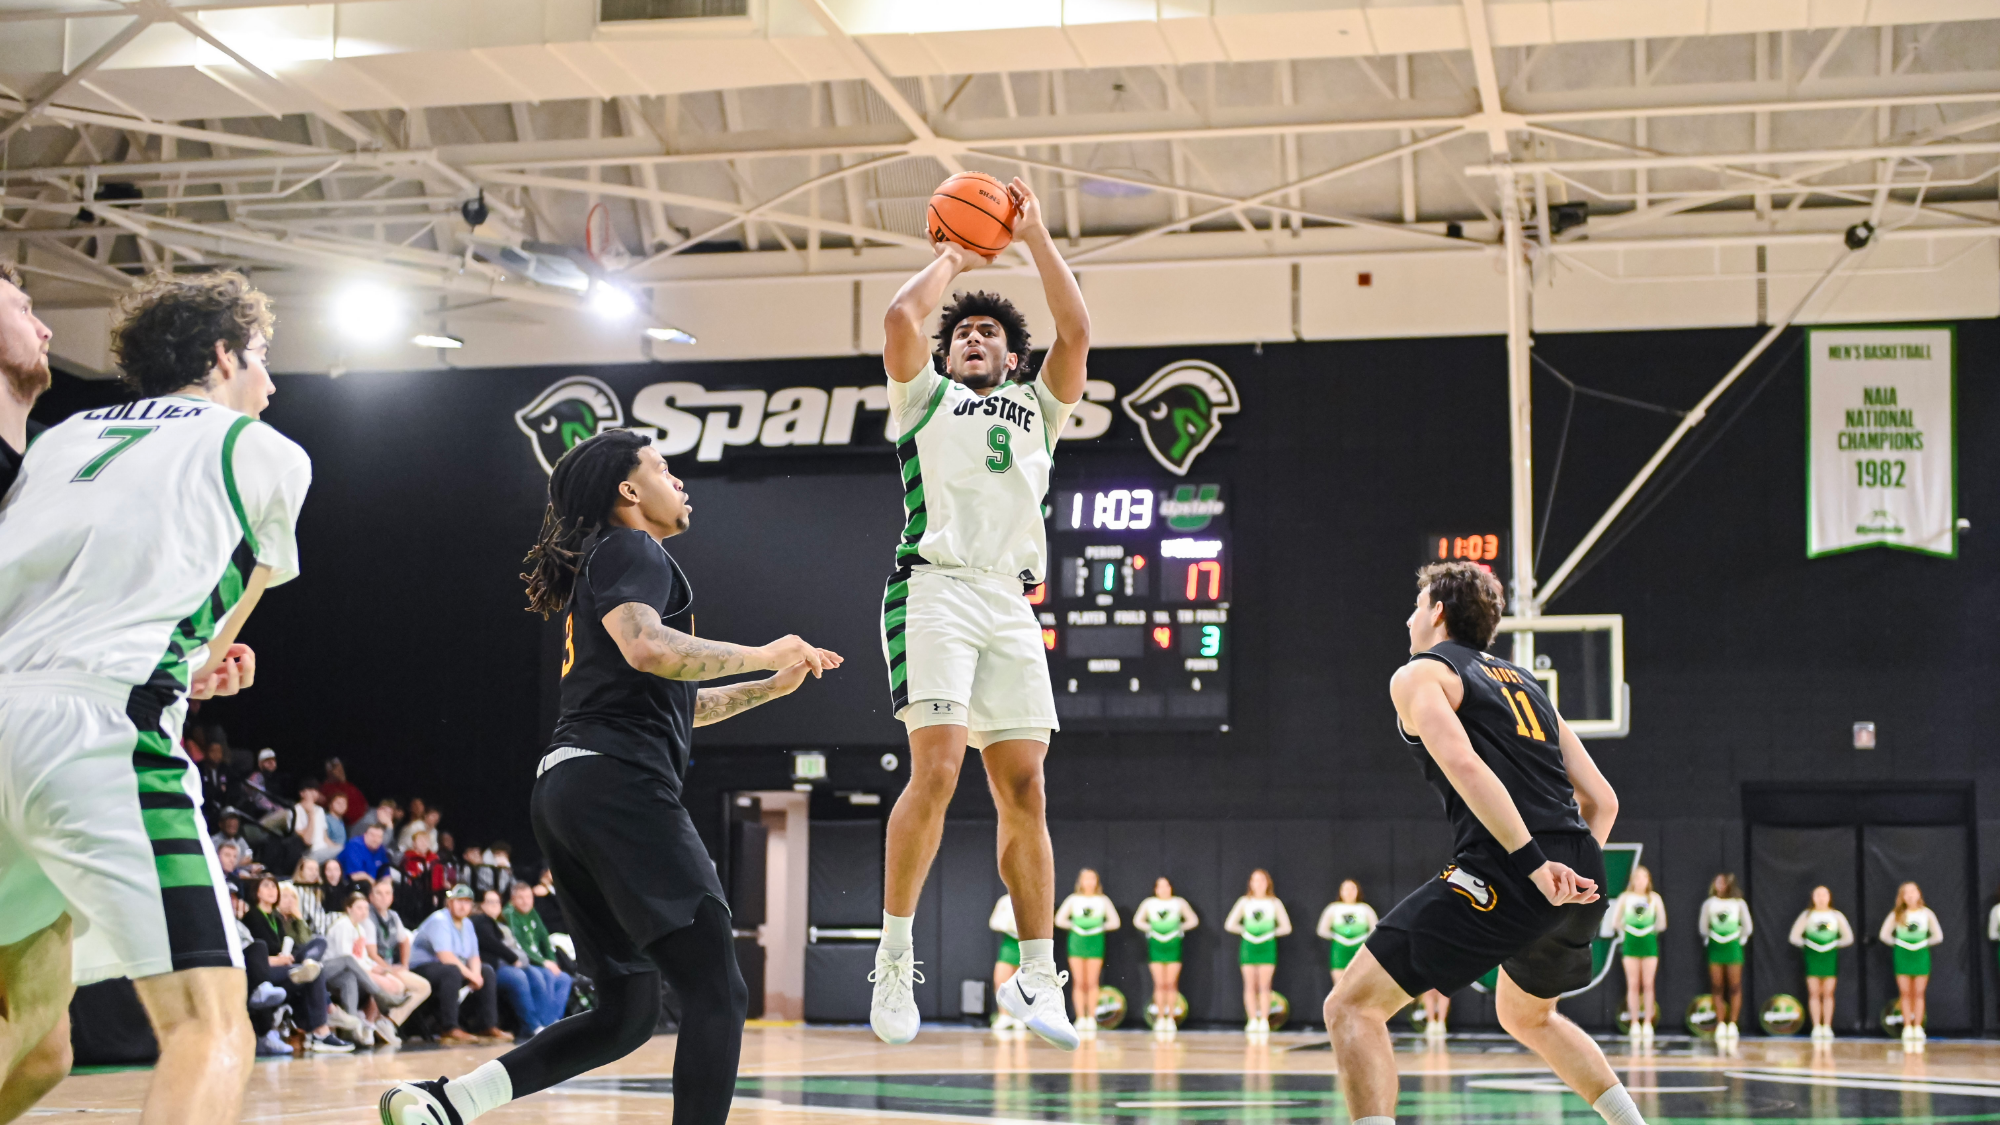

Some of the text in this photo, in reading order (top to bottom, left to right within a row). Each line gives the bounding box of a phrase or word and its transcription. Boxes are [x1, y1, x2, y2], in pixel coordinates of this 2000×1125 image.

[1828, 344, 1931, 360] MEN'S BASKETBALL
[1863, 386, 1897, 406] NAIA
[630, 381, 1116, 462] Spars
[953, 396, 1035, 433] UPSTATE
[1845, 409, 1914, 428] NATIONAL
[69, 425, 161, 483] 7
[986, 424, 1012, 473] 9
[1838, 431, 1924, 450] CHAMPIONS
[1856, 459, 1906, 488] 1982
[1071, 489, 1154, 531] 11:03
[1438, 534, 1499, 561] 11:03
[1103, 563, 1115, 591] 1
[1186, 561, 1221, 600] 17
[1067, 610, 1107, 625] PLAYER
[1200, 625, 1221, 657] 3
[1501, 687, 1546, 742] 11
